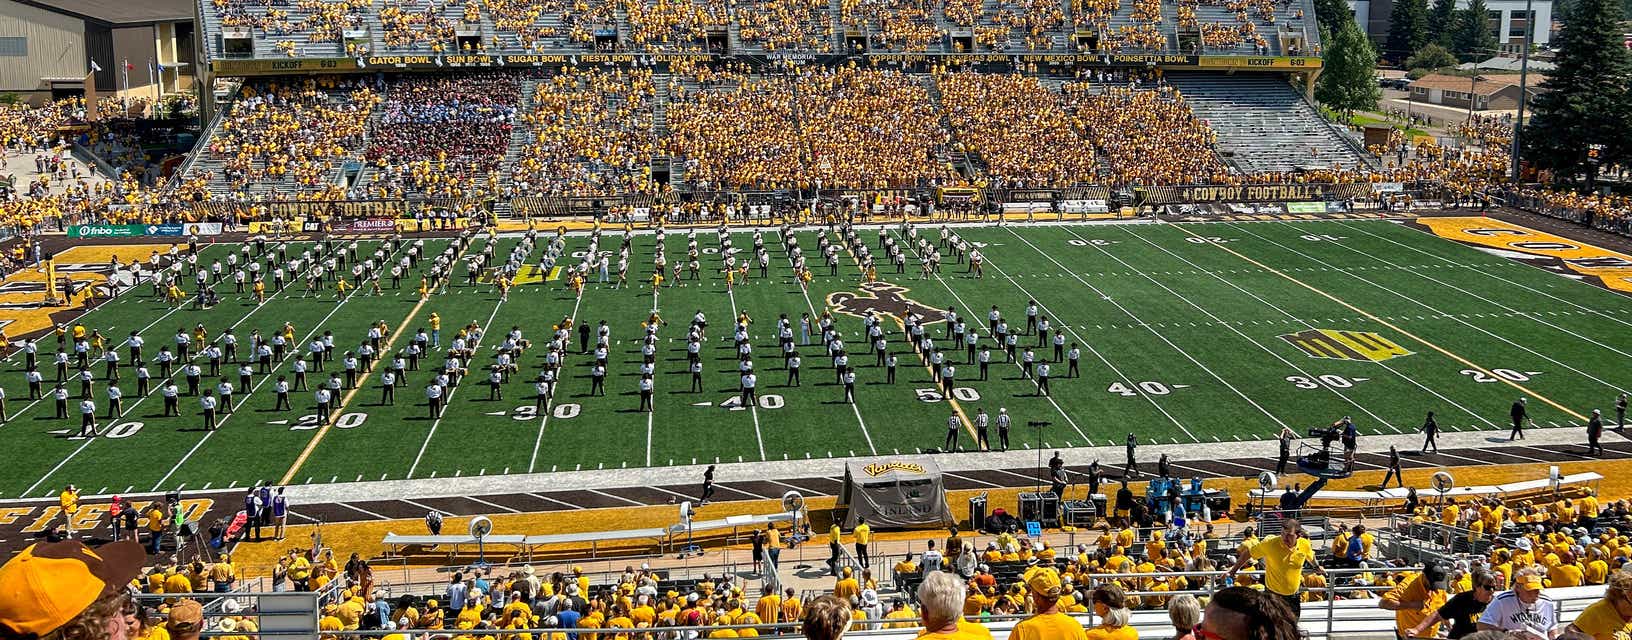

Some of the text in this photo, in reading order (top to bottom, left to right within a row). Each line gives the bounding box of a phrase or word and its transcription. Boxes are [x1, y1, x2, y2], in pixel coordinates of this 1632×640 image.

[272, 60, 302, 70] KICKOFF
[369, 56, 432, 64] GATOR BOWL
[446, 56, 466, 64] SUN
[1194, 186, 1312, 200] COWBOY FOOTBALL
[91, 226, 112, 235] fnbo
[304, 222, 319, 230] CAT
[1286, 374, 1354, 390] 30
[1458, 367, 1528, 385] 20
[914, 386, 982, 402] 50
[1107, 381, 1170, 396] 40
[720, 394, 785, 411] 40
[512, 403, 582, 420] 30
[289, 412, 368, 430] 20
[1510, 610, 1548, 626] WYOMING
